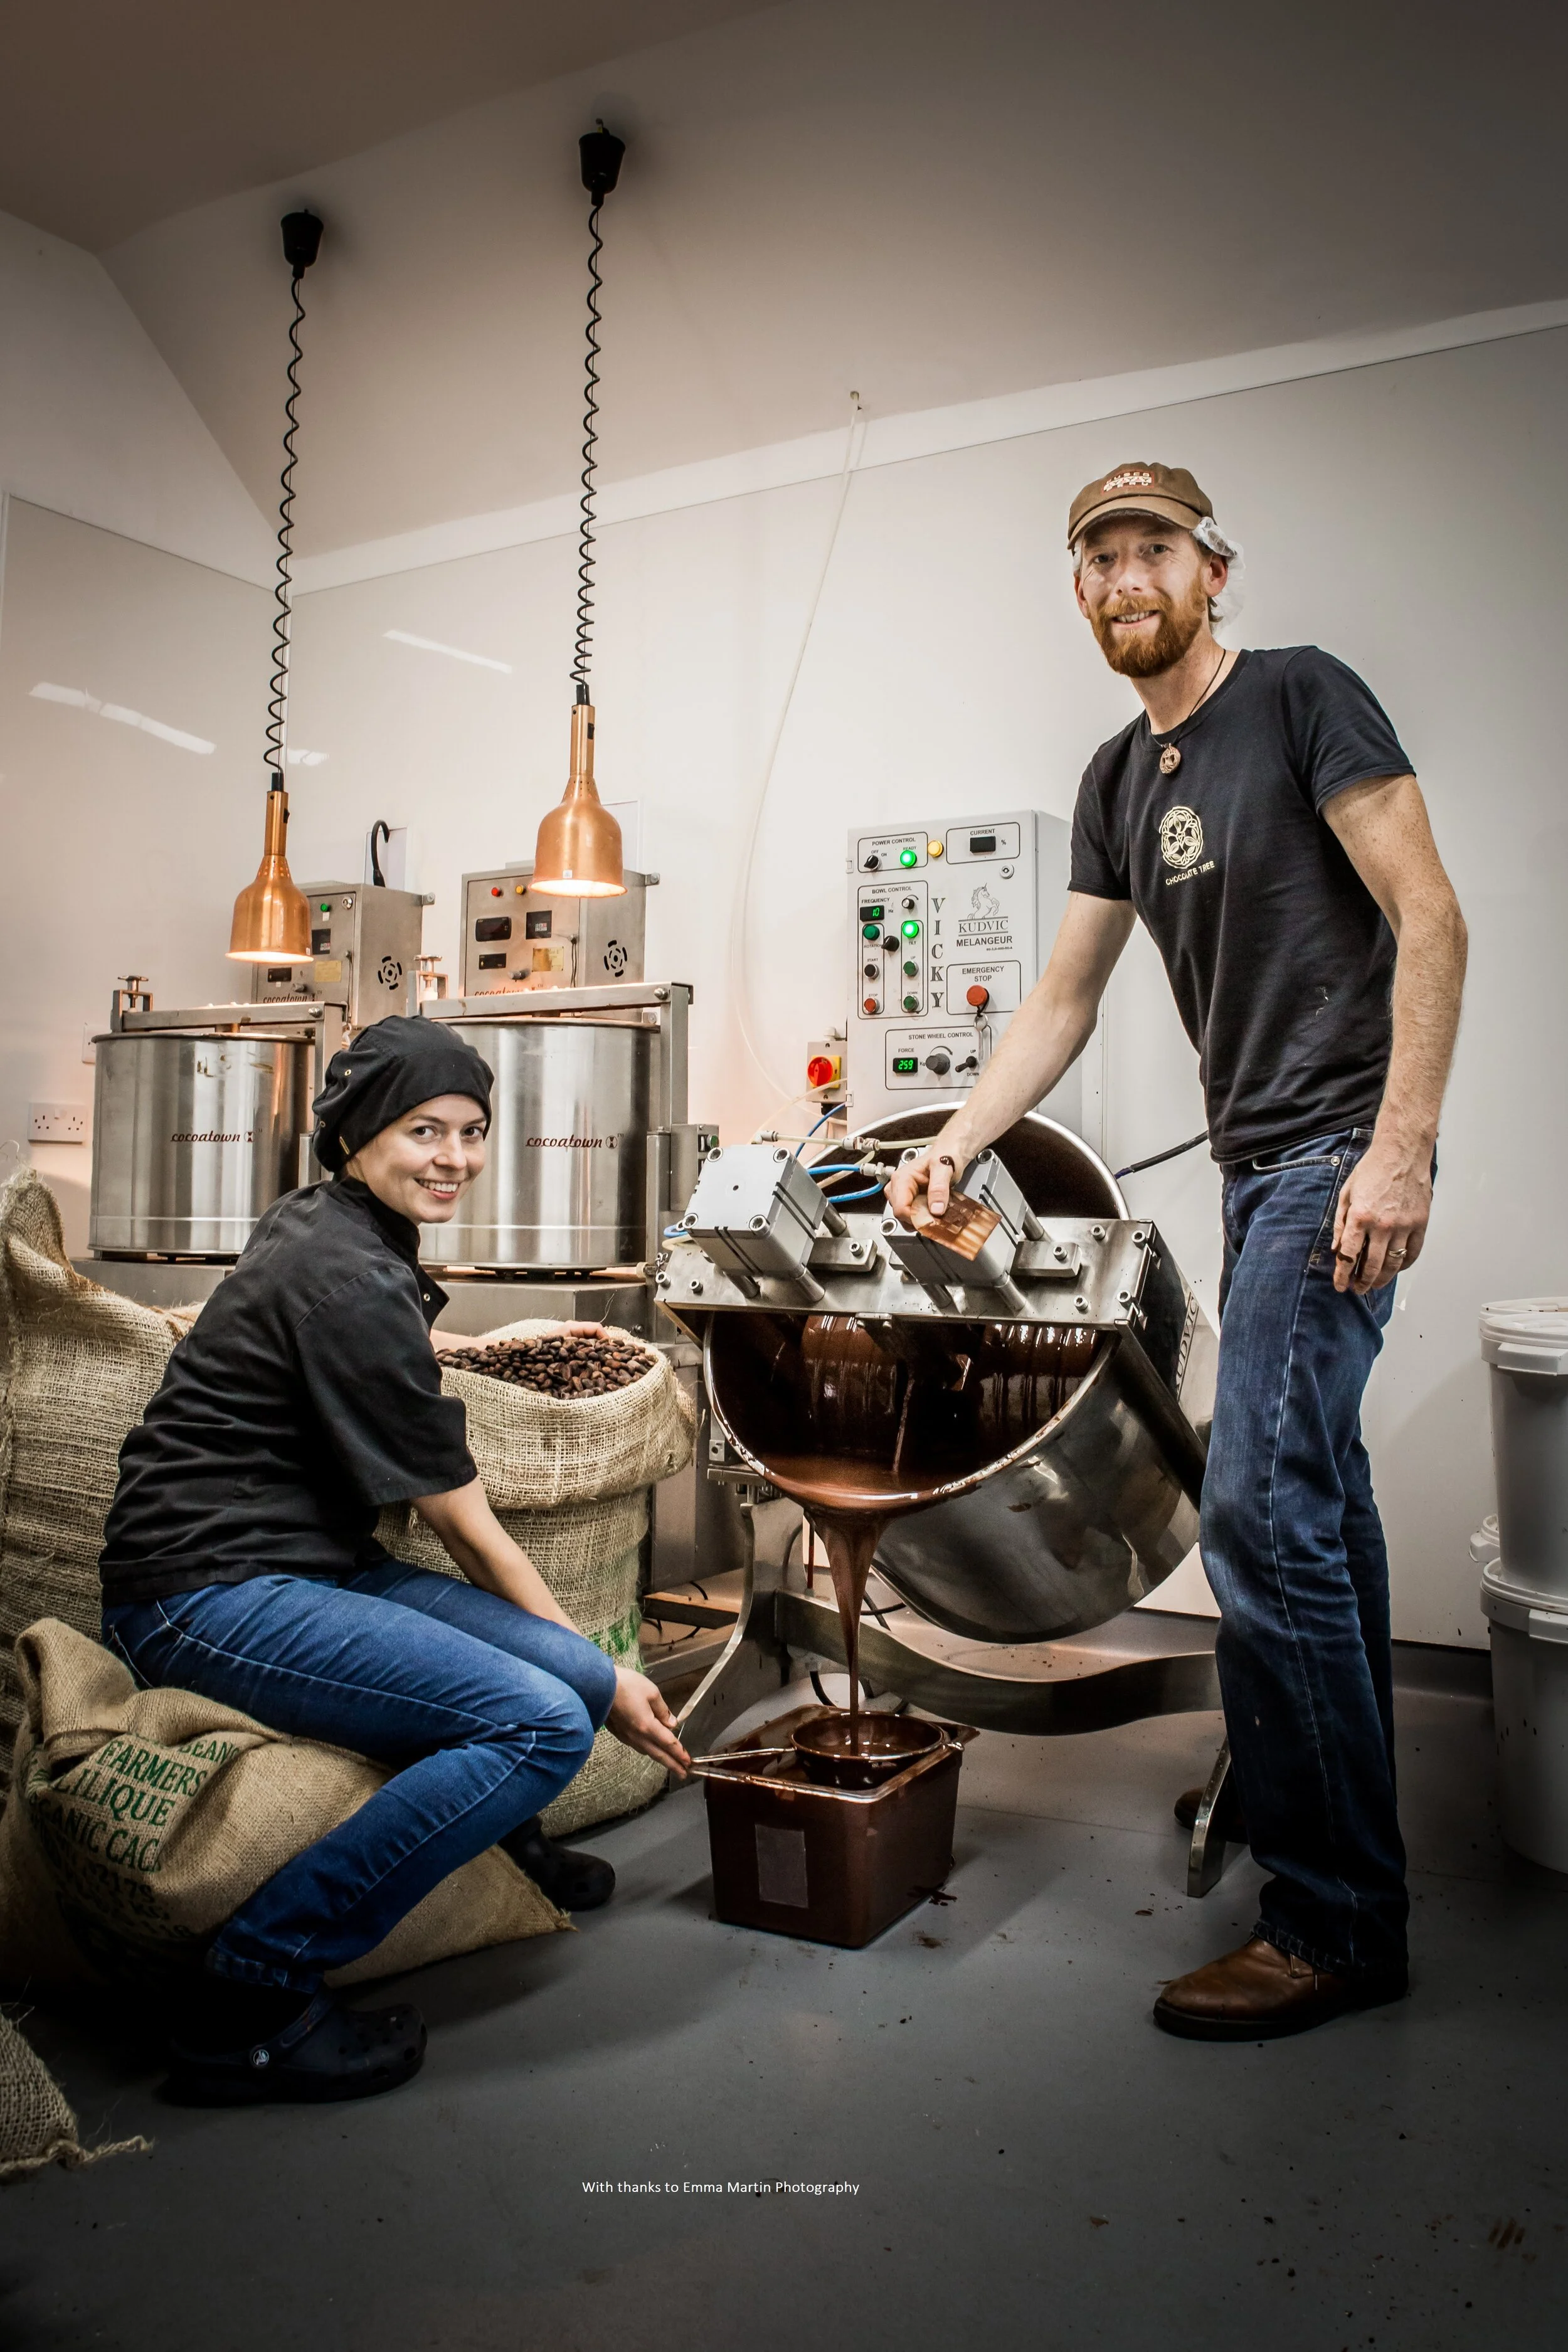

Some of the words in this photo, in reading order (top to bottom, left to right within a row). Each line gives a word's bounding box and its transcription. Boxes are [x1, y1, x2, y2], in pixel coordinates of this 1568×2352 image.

[1165, 867, 1198, 886] CHOCOLATE
[1198, 861, 1215, 873] TREE
[872, 908, 880, 916] 10
[958, 919, 1009, 933] KUDVIC
[956, 936, 1013, 947] MELANGEUR
[962, 965, 1004, 975] EMERGENCY
[170, 1130, 240, 1142] cocoatown
[526, 1134, 603, 1148] cocoatown
[96, 1740, 209, 1798] FARMERS
[105, 1829, 162, 1873] CAC
